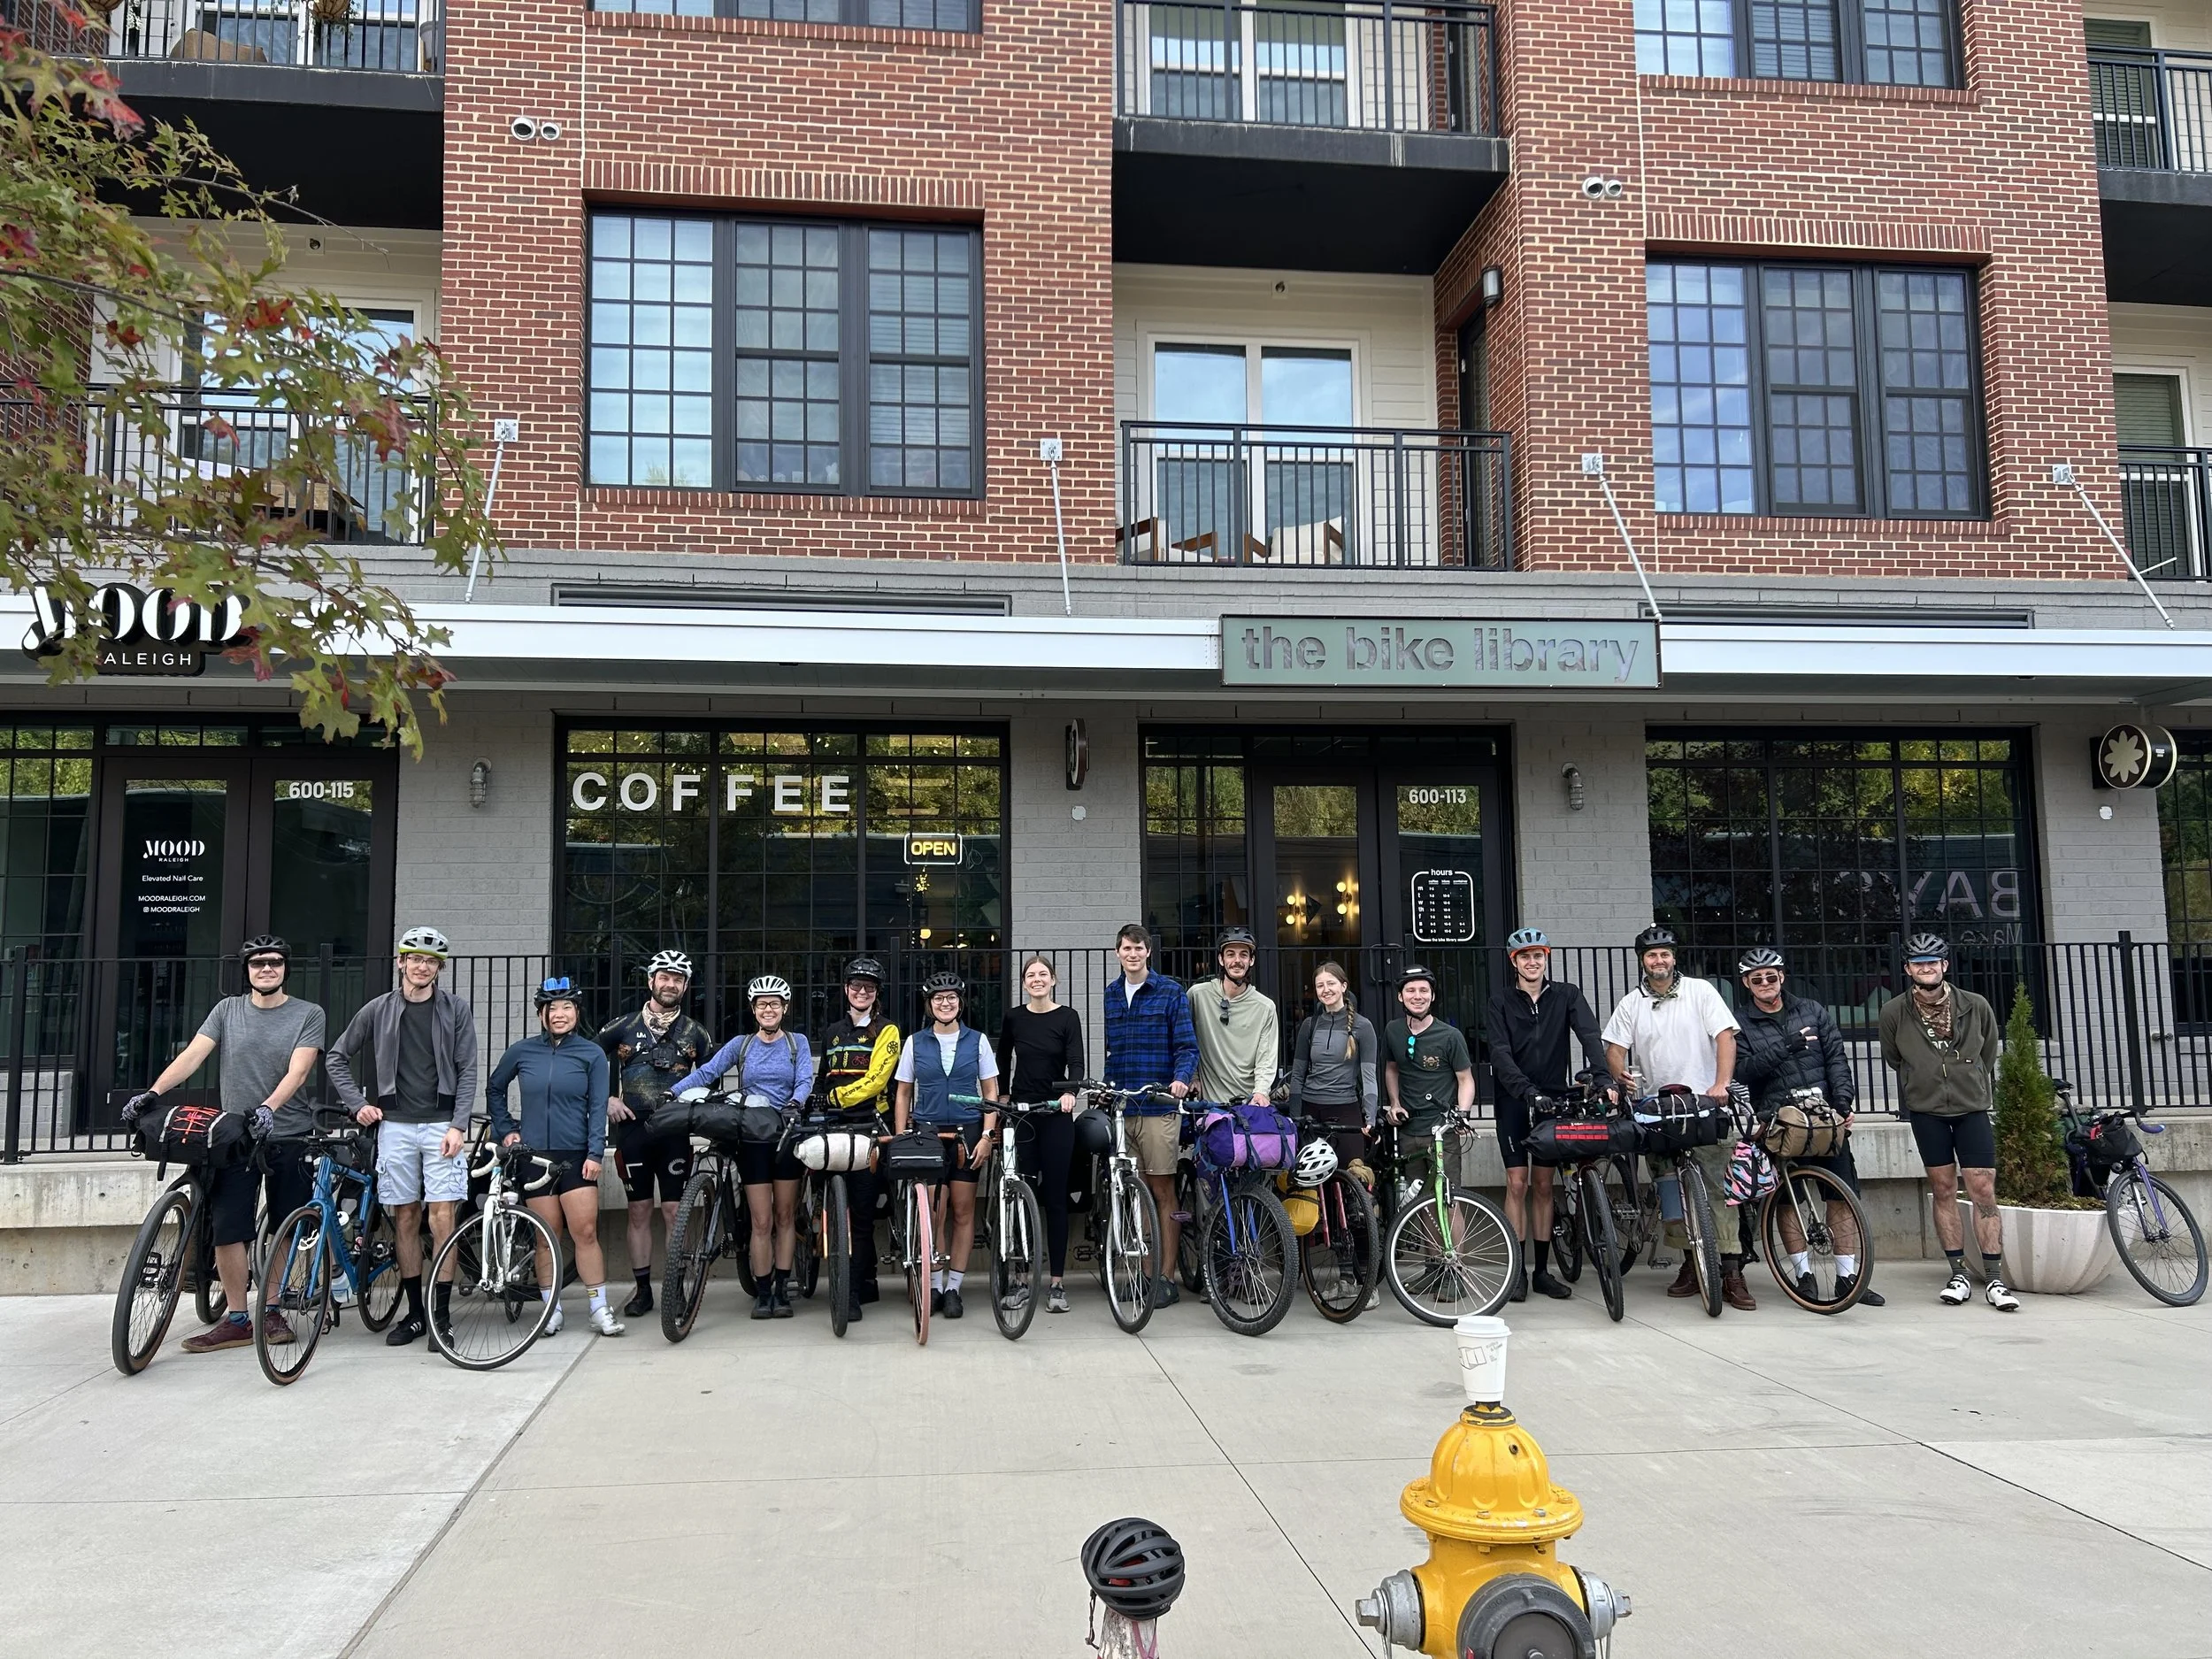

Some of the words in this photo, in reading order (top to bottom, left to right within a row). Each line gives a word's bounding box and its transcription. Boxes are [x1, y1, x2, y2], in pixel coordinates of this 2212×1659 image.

[96, 652, 192, 665] ALEIGH
[1241, 626, 1326, 671] the
[1346, 626, 1455, 672] bike
[1474, 627, 1640, 684] library
[288, 781, 354, 799] 600-115
[572, 772, 850, 811] COFFEE
[1409, 788, 1467, 804] 600-113
[142, 840, 205, 859] MOOD
[910, 841, 956, 856] OPEN
